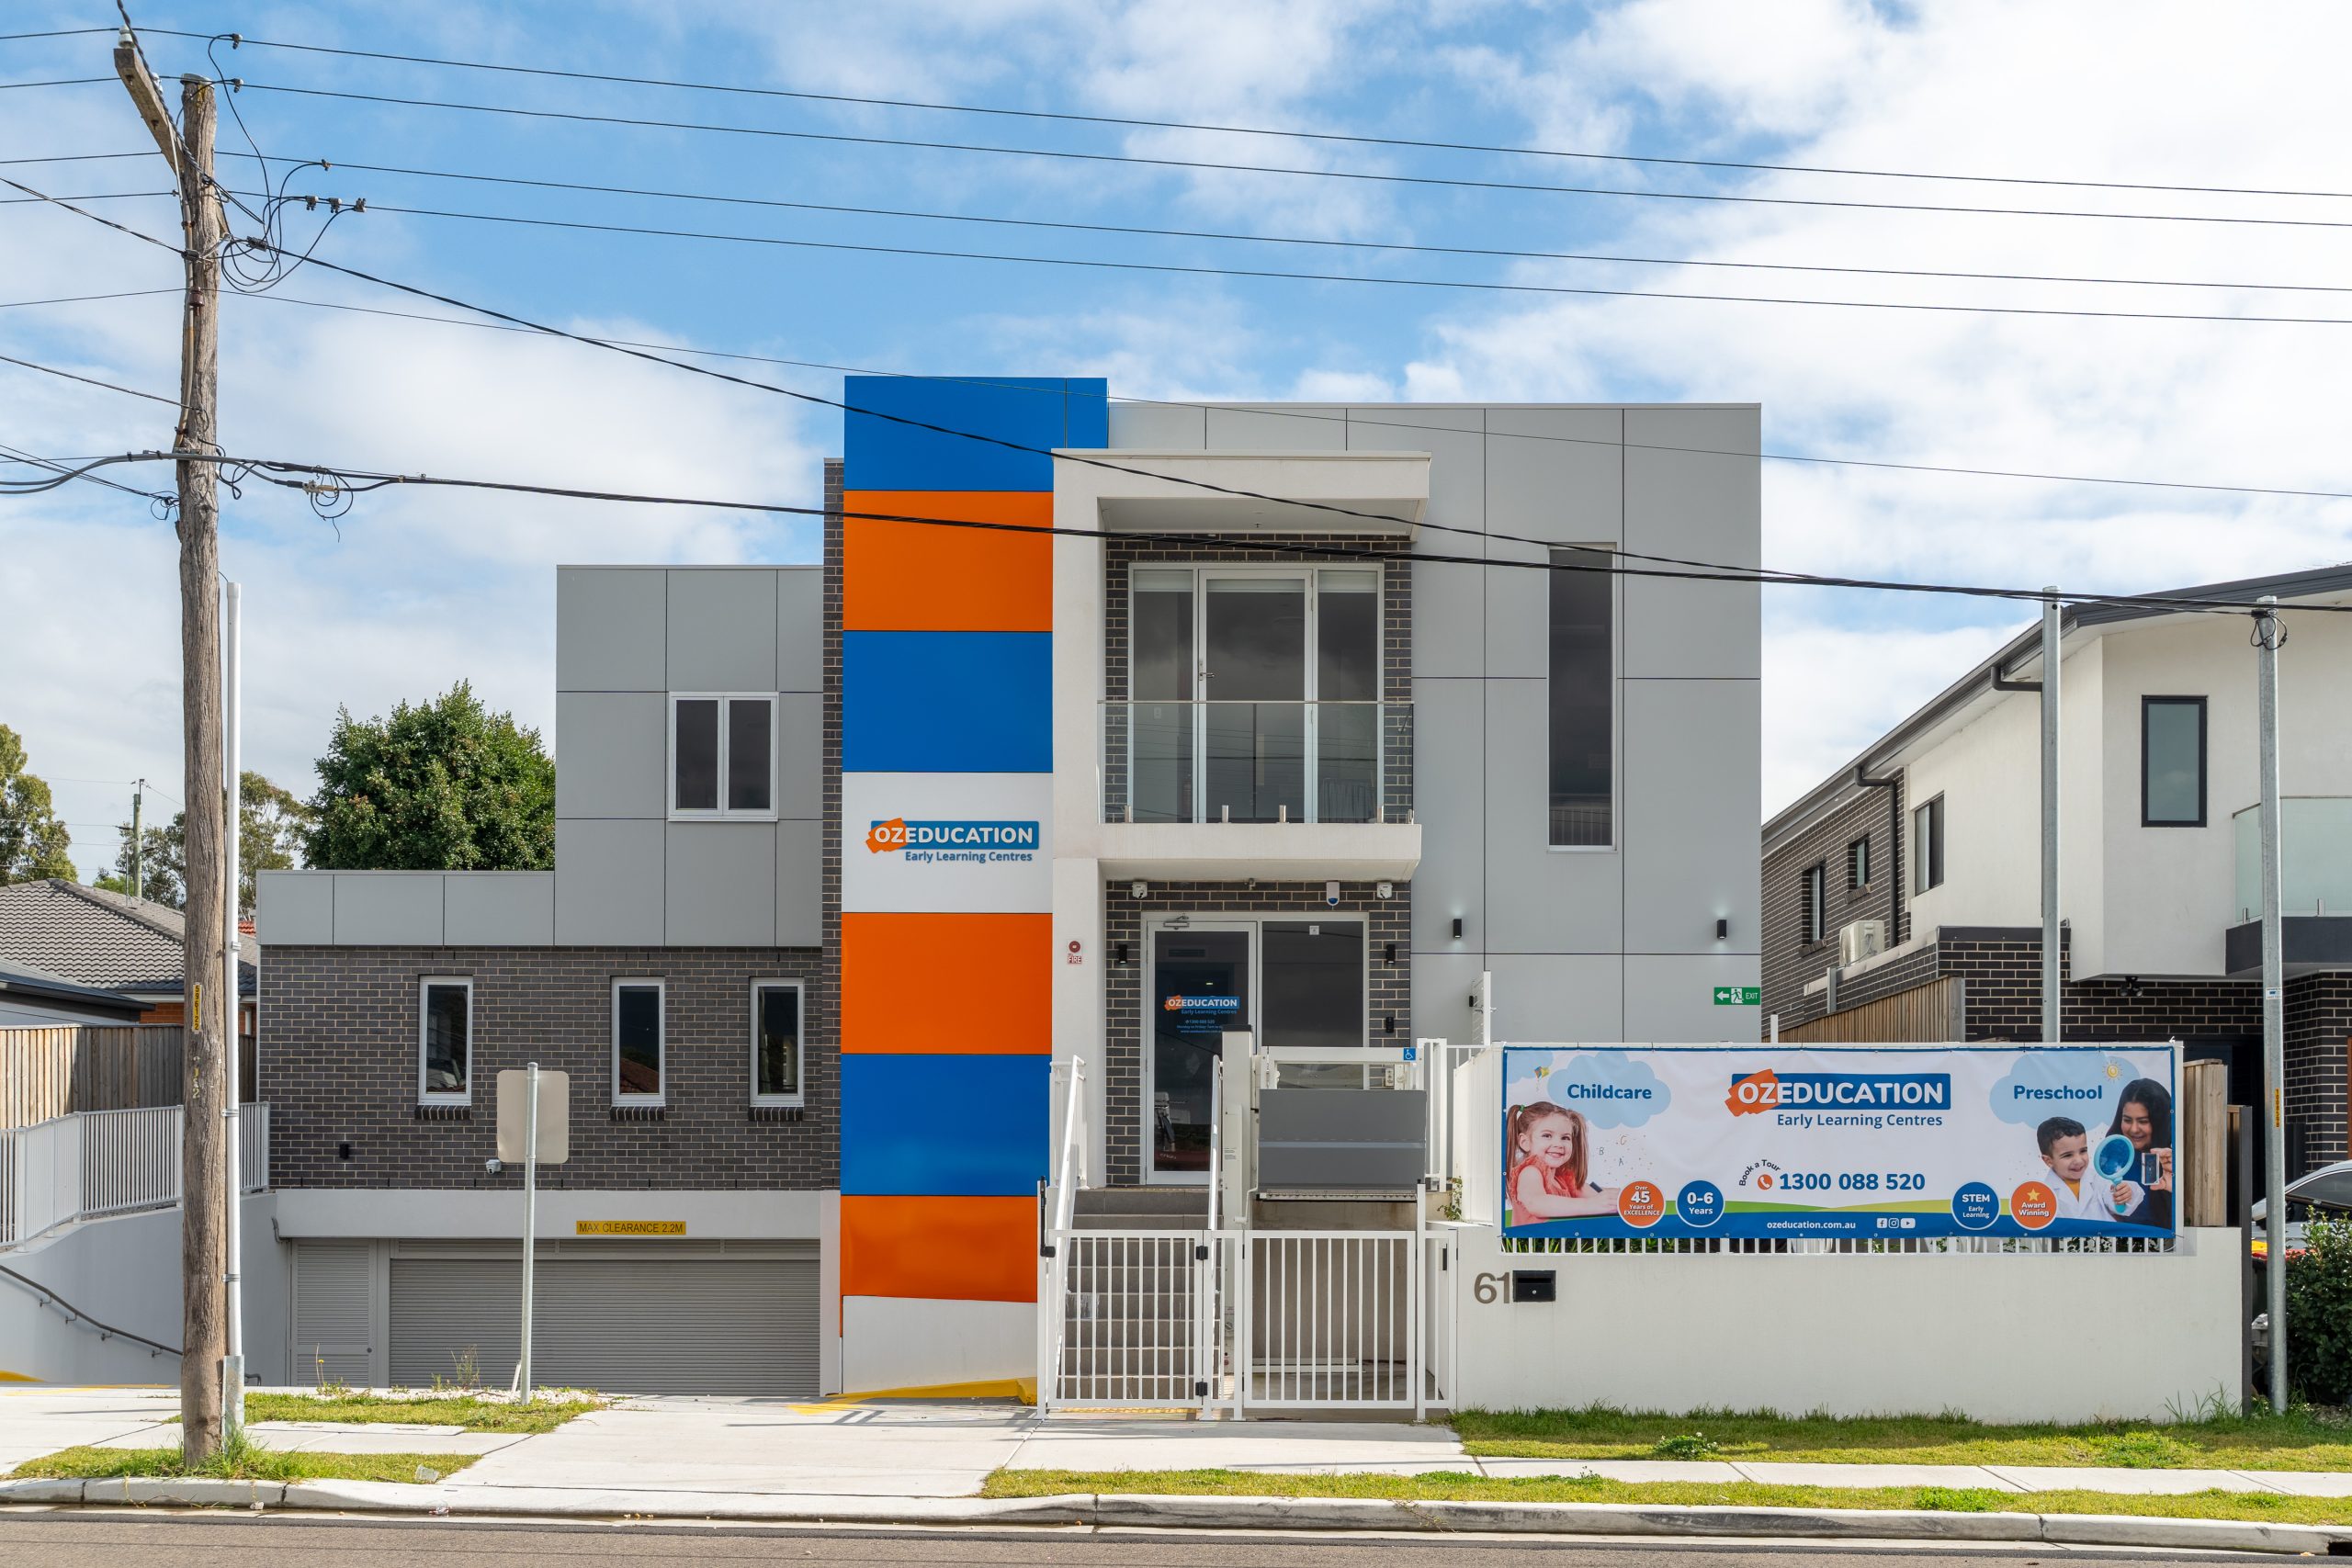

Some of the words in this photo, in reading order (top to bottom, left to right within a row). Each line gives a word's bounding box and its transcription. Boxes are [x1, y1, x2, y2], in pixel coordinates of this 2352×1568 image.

[874, 827, 1034, 844] OZEDUCATION
[905, 852, 933, 863] Early
[936, 852, 986, 863] Learning
[989, 852, 1033, 862] Centres
[1168, 998, 1238, 1007] OZEDUCATION
[1566, 1083, 1652, 1100] Childcare
[1737, 1082, 1943, 1104] OZEDUCATION
[2014, 1085, 2102, 1100] Preschool
[1777, 1113, 1813, 1129] Early
[1817, 1113, 1883, 1129] Learning
[1886, 1114, 1942, 1126] Centres
[1738, 1166, 1754, 1186] Book
[1761, 1159, 1781, 1171] Tour
[1780, 1173, 1831, 1190] 1300
[1838, 1173, 1879, 1190] 088
[1886, 1173, 1926, 1190] 520
[1631, 1191, 1650, 1203] 45
[1962, 1194, 1990, 1202] STEM
[2018, 1209, 2050, 1217] Winning
[579, 1223, 599, 1233] MAX
[602, 1223, 659, 1233] CLEARANCE
[662, 1223, 684, 1233] 2.2M
[1767, 1220, 1856, 1229] ozeducation.com.au
[1474, 1272, 1510, 1304] 61
